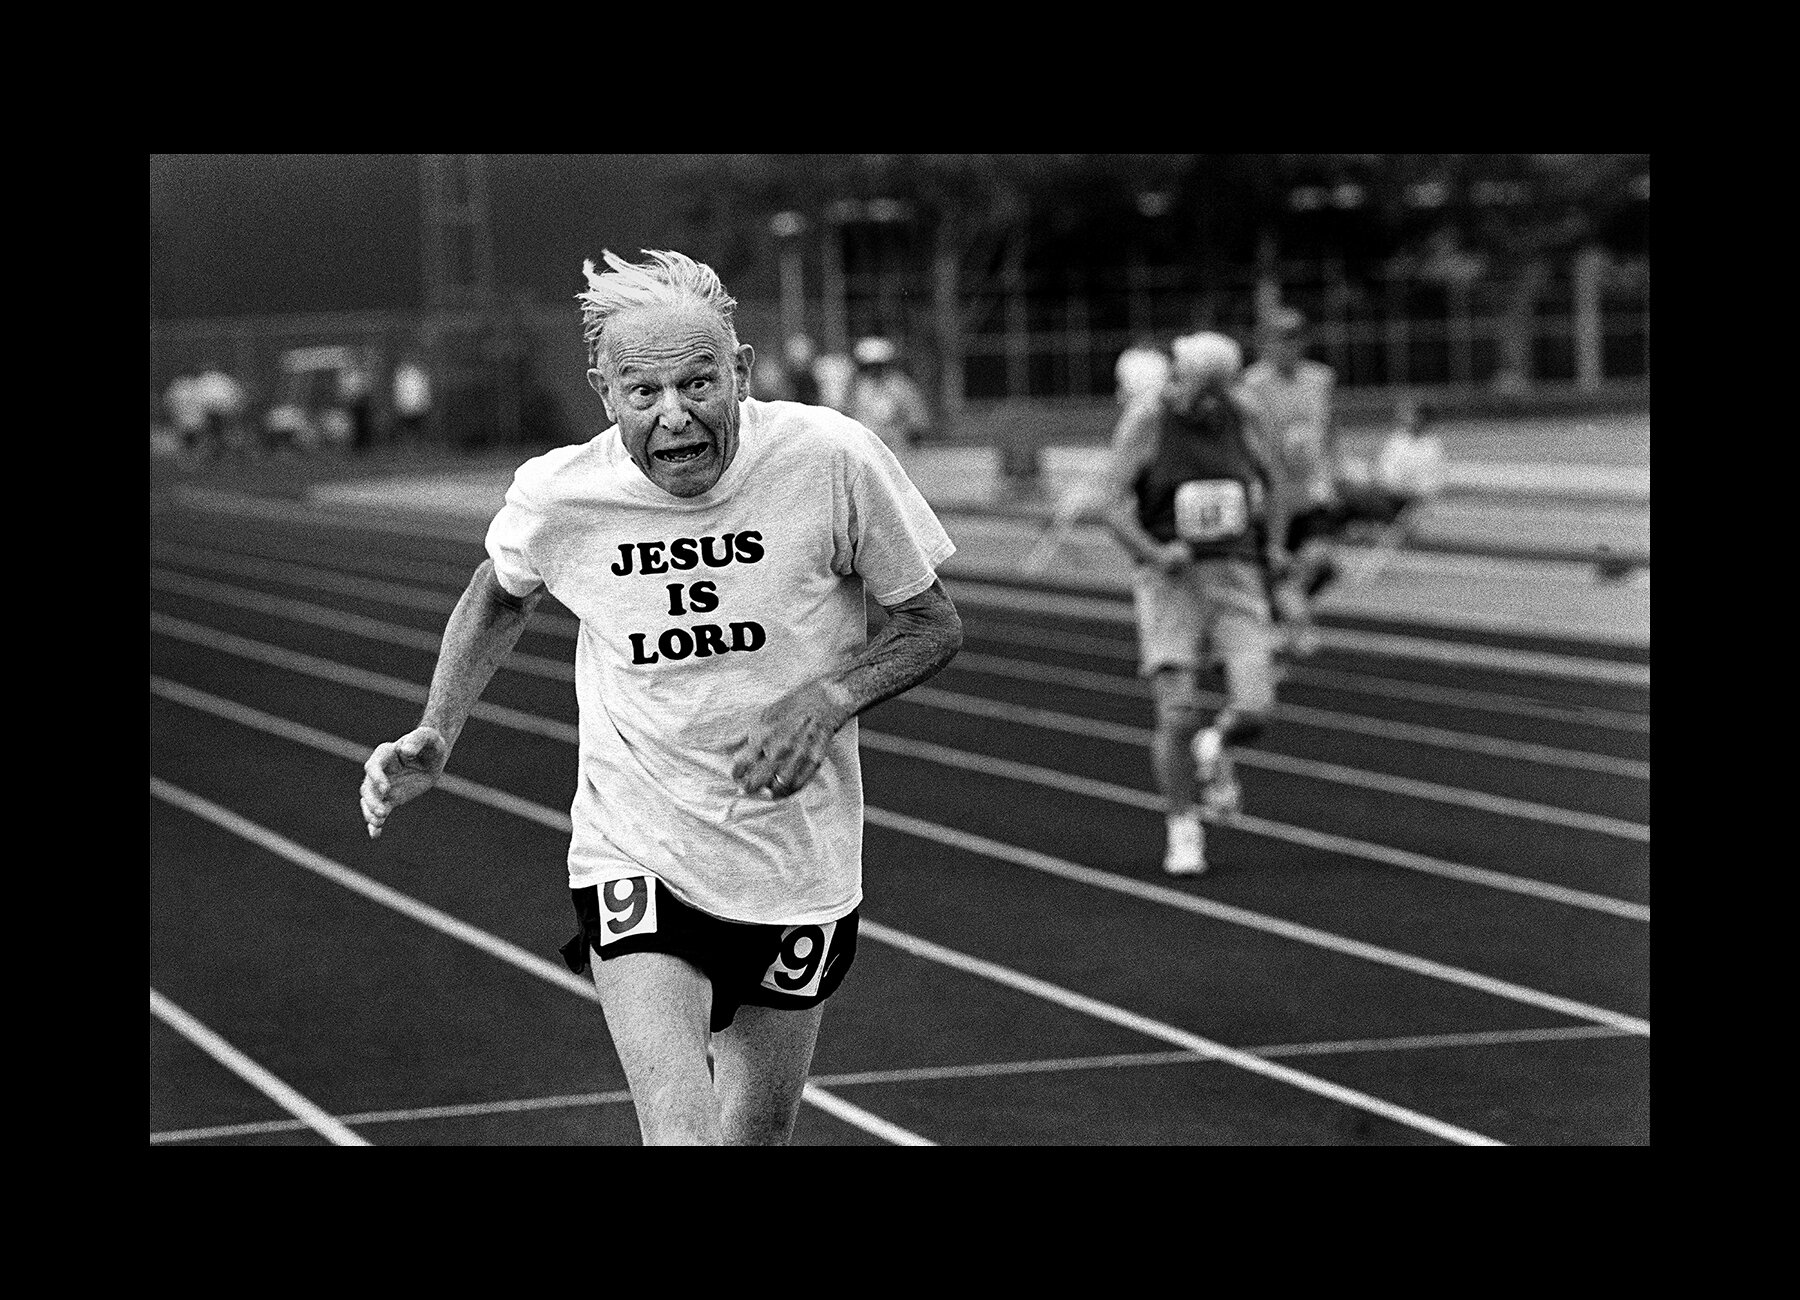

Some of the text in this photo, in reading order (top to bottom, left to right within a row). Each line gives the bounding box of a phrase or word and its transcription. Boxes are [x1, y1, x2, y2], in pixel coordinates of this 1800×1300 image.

[611, 530, 765, 577] JESUS
[666, 581, 719, 616] IS
[628, 621, 766, 665] LORD
[603, 876, 648, 934] 9
[774, 924, 826, 991] 9
